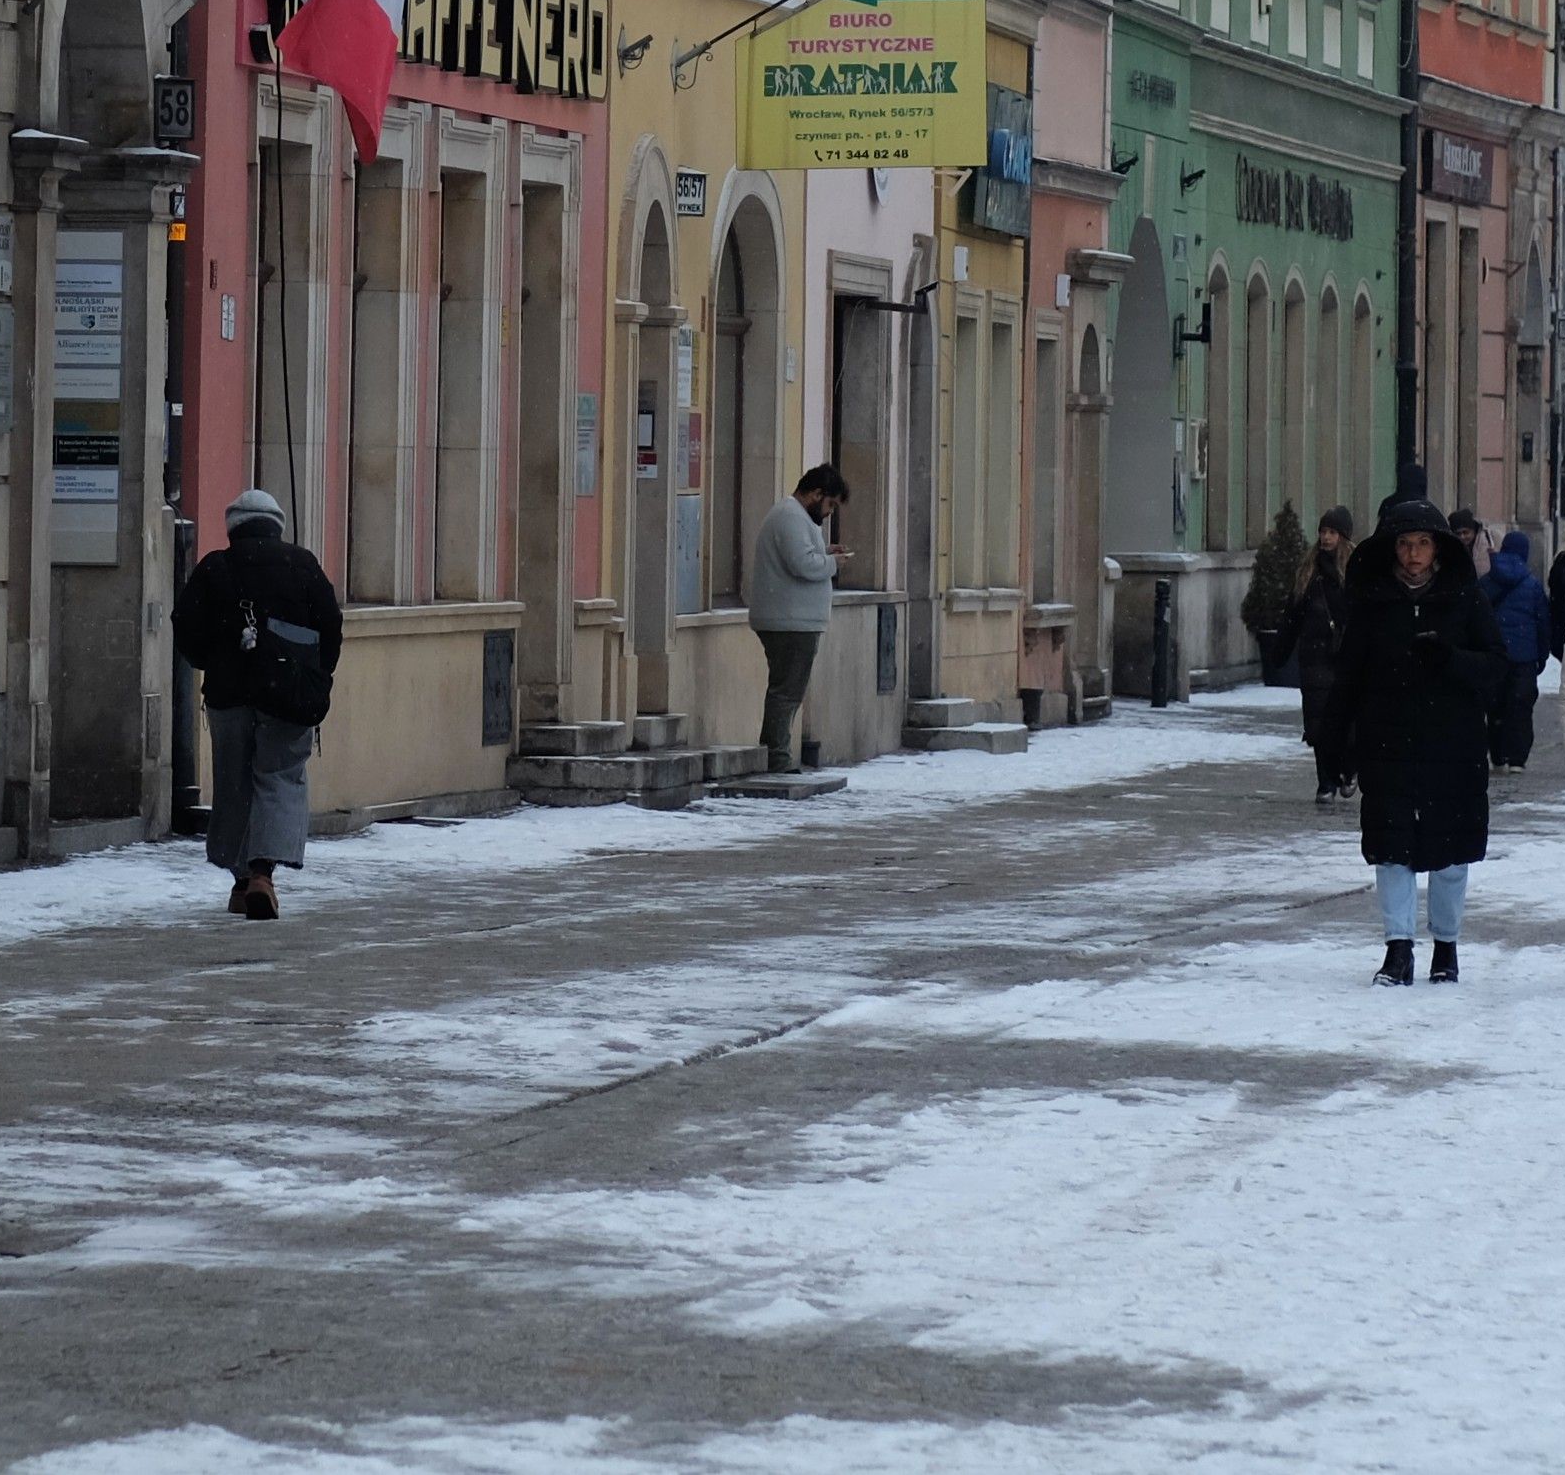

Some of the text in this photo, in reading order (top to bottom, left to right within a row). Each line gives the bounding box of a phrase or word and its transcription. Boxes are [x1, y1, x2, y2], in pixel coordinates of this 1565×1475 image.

[829, 13, 892, 28] BIURO
[788, 38, 934, 54] TURYSTYCZNE
[764, 62, 958, 97] BRATNIAK
[160, 88, 189, 126] 58
[789, 107, 934, 120] Wrocław, Rynek 56/57/3
[795, 131, 842, 142] czynne:
[845, 131, 864, 141] pn.
[875, 130, 891, 140] pt.
[894, 129, 902, 139] 9
[914, 128, 929, 139] 17
[826, 149, 909, 160] 71 344 82 48
[678, 176, 703, 198] 56/57
[678, 204, 702, 212] RYNEK
